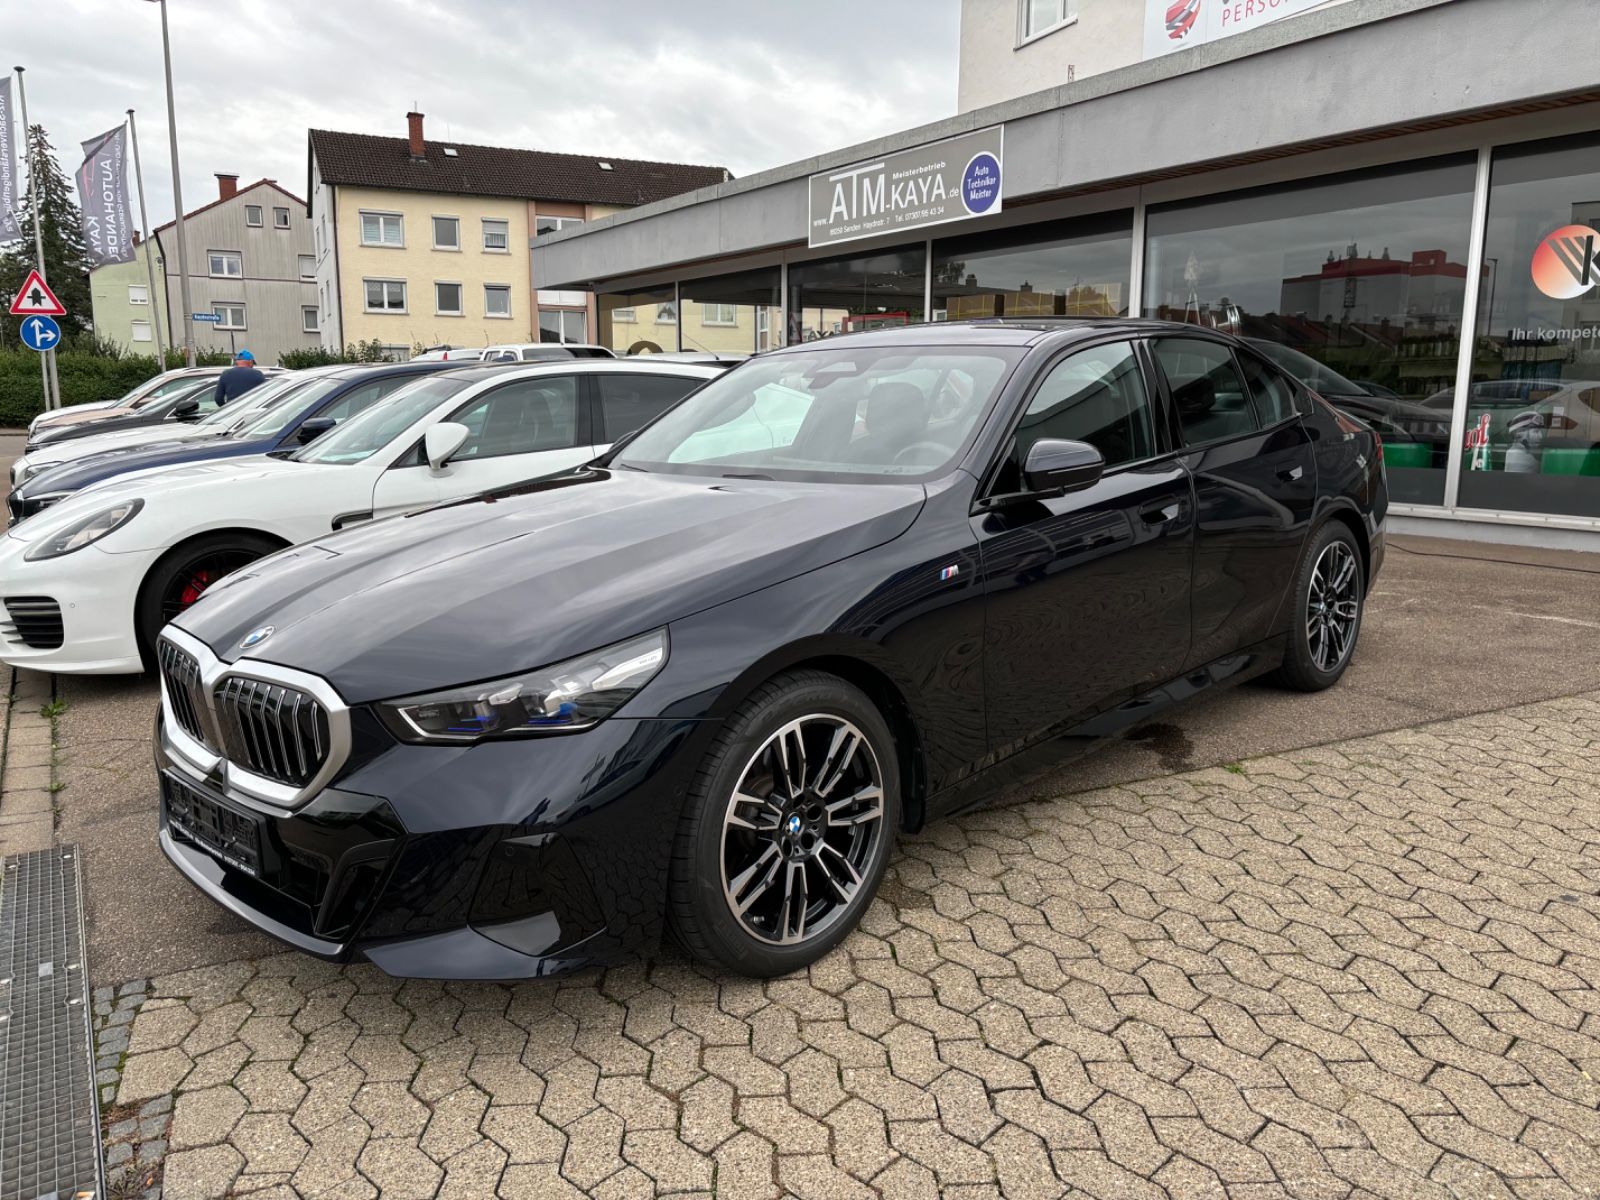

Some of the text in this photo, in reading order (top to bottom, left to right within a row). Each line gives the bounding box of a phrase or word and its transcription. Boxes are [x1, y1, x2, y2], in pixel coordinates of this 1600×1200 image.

[892, 161, 946, 181] Meisterbetrieb
[974, 166, 989, 177] Auto
[970, 189, 992, 201] Meister
[1511, 327, 1533, 341] Ihr
